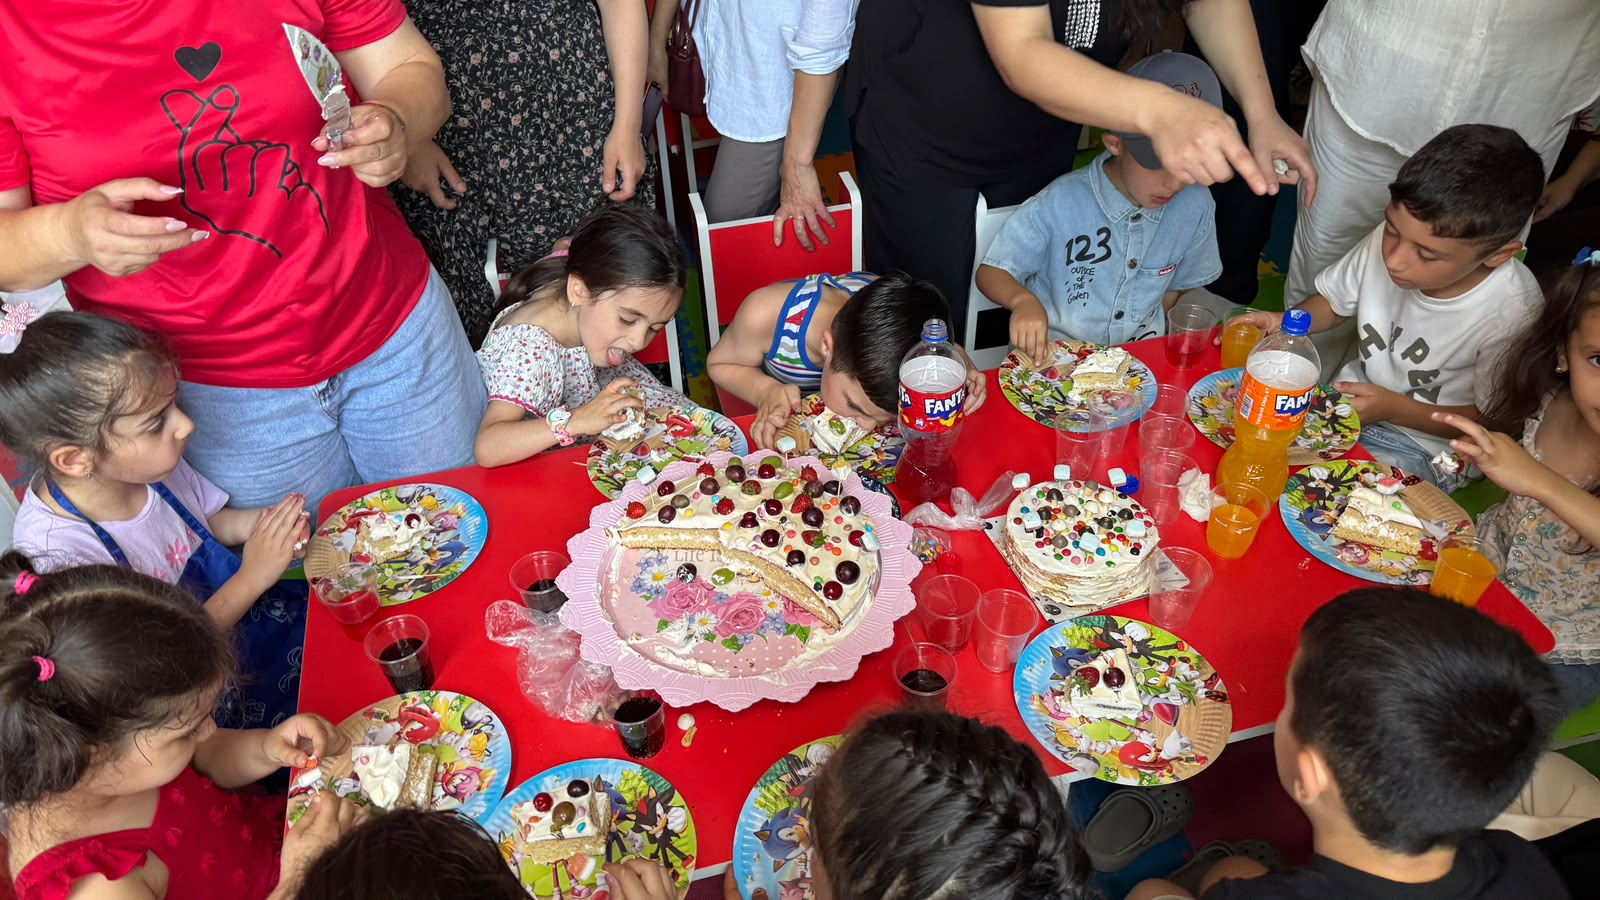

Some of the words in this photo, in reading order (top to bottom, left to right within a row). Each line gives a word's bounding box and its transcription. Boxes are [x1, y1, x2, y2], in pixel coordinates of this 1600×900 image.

[1065, 226, 1112, 266] 123
[1073, 282, 1086, 291] THE
[674, 550, 704, 562] Life
